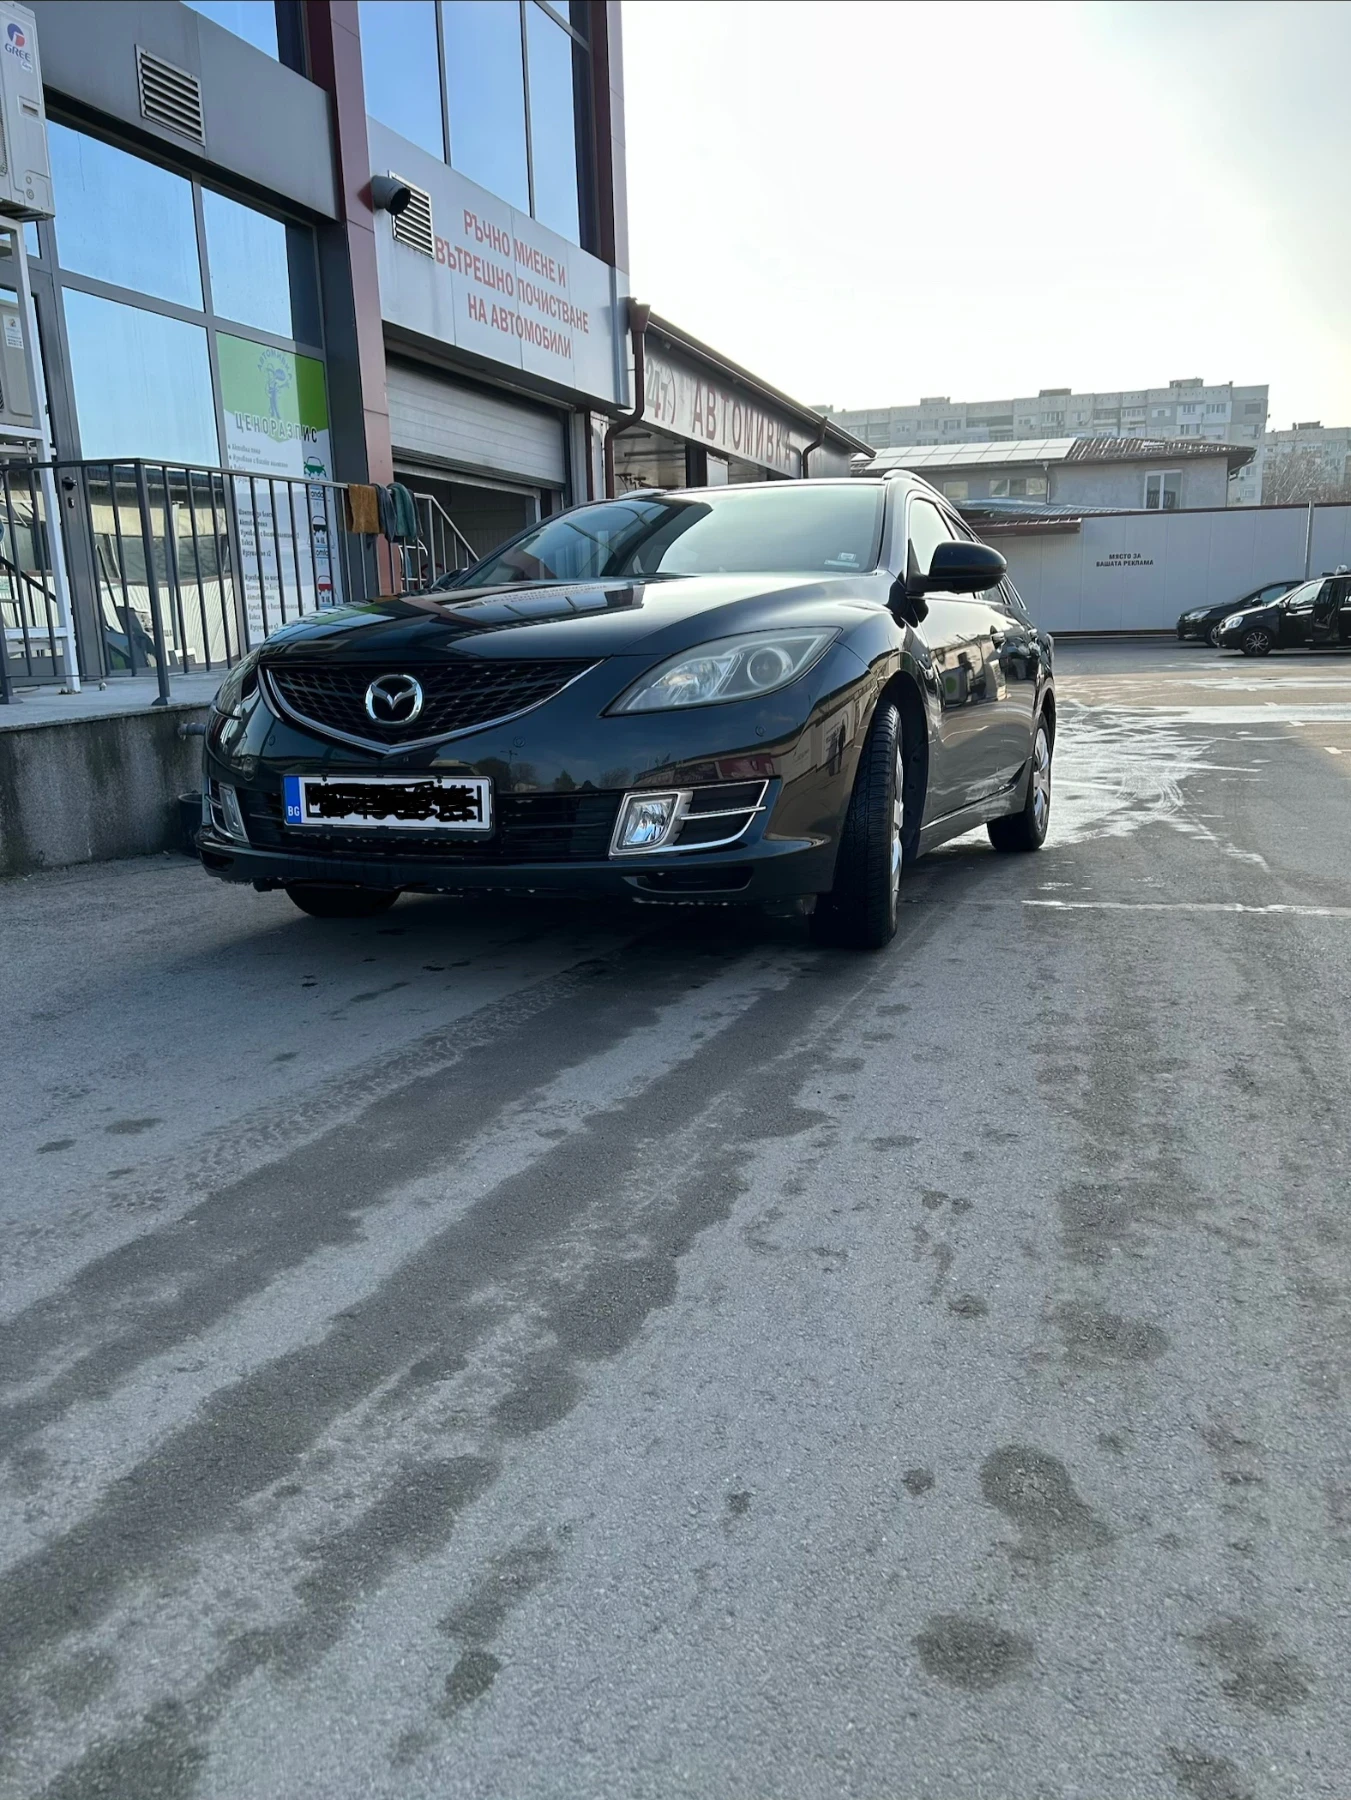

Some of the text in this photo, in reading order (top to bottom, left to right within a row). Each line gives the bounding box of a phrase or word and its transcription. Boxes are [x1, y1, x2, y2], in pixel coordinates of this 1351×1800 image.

[4, 43, 31, 63] GREE
[463, 209, 566, 288] РЪЧНО МИЕНЕ И
[434, 235, 589, 334] ВЪТРЕШНО ПОЧИСТВАНЕ
[467, 293, 571, 359] НА АВТОМОБИЛИ
[234, 411, 317, 443] ЦЕНОРАЗПИС
[691, 378, 791, 472] АВТОМИВКА
[1123, 559, 1154, 567] РЕКЛАМА
[287, 805, 300, 817] BG
